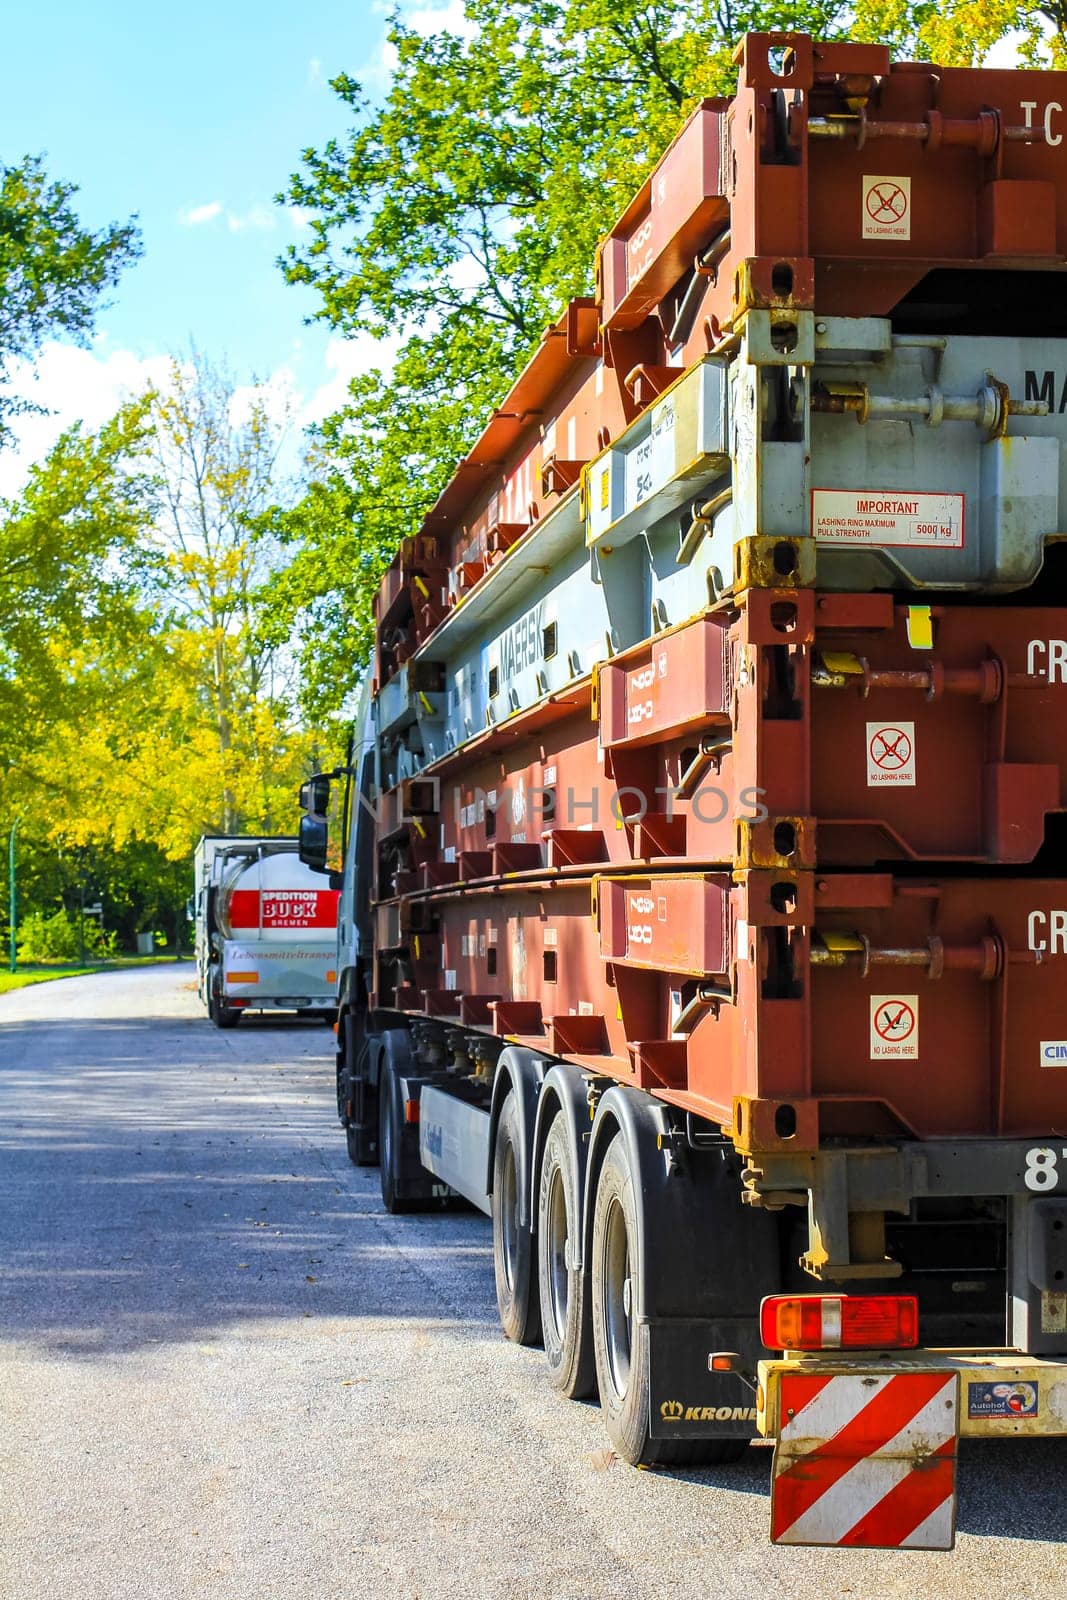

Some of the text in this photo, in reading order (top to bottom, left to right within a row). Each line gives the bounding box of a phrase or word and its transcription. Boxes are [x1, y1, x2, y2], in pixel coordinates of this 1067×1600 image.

[857, 500, 919, 513] IMPORTANT
[818, 518, 895, 528] LASHING RING MAXIMUM
[818, 528, 870, 537] PULL STRENGTH
[916, 524, 951, 537] 5000 kg
[499, 604, 543, 684] MAERSK
[262, 892, 317, 901] SPEDITION
[263, 902, 316, 918] BUCK
[873, 1046, 880, 1054] NO
[882, 1046, 900, 1054] LASHING
[1024, 1147, 1067, 1191] 8
